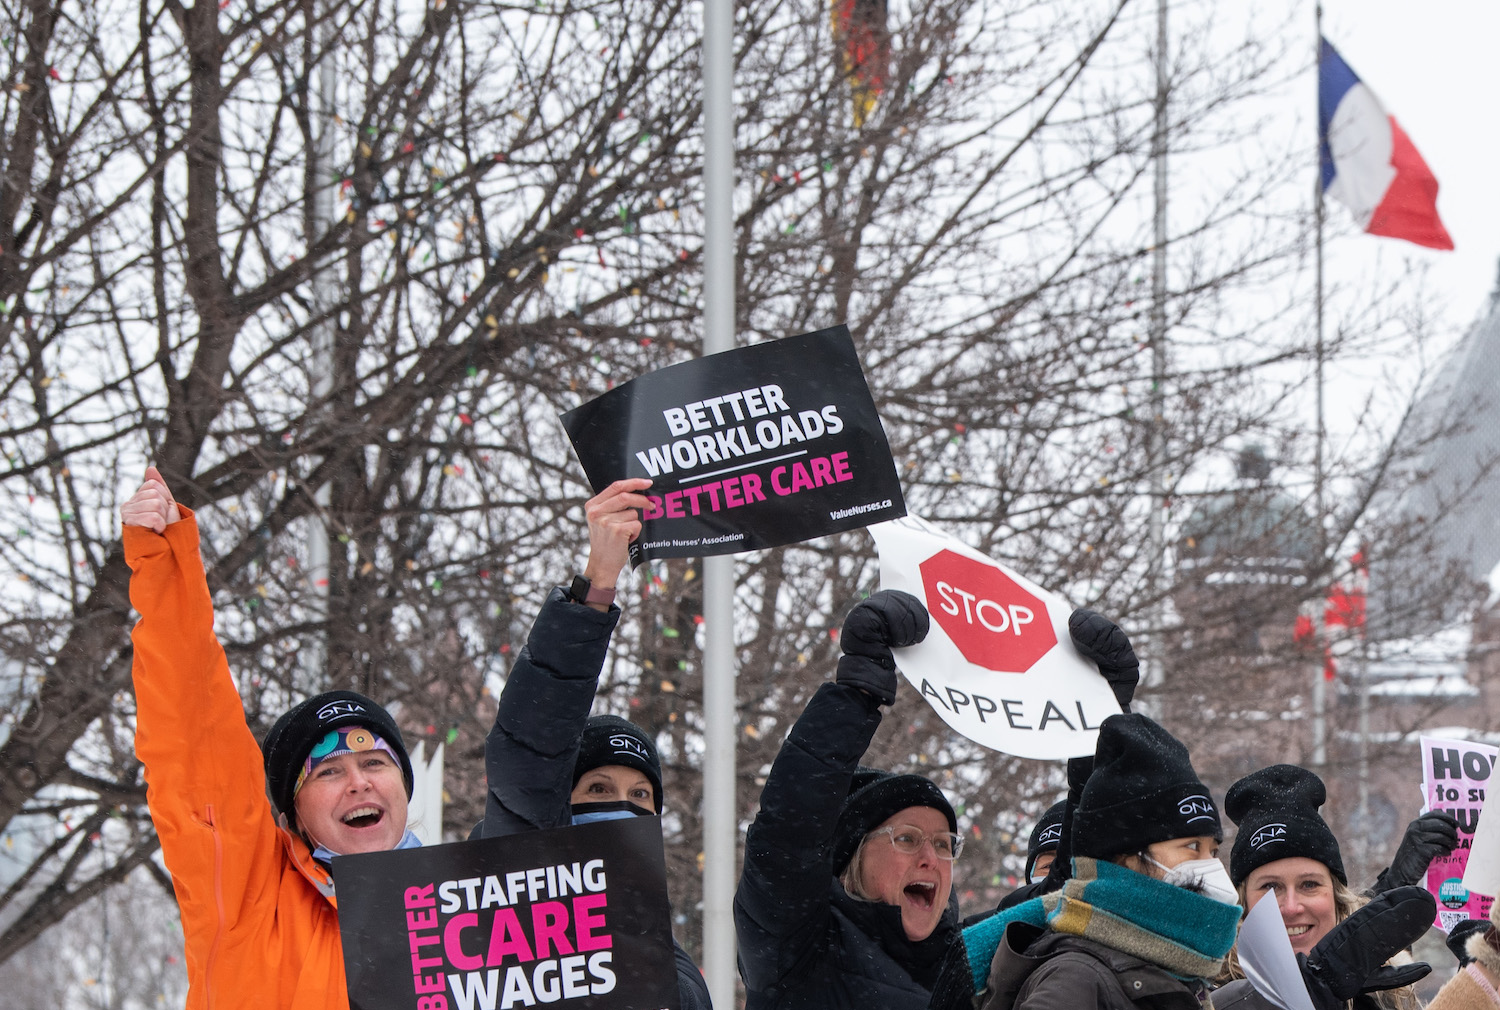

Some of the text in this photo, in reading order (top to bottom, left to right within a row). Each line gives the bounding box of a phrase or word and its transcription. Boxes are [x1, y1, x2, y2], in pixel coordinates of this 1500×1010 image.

[663, 384, 790, 437] BETTER
[636, 405, 844, 477] WORKLOADS
[642, 451, 854, 520] BETTER CARE
[830, 499, 892, 521] ValueNurses.ca
[643, 540, 671, 550] Ontario
[701, 533, 745, 545] Association
[936, 581, 1034, 636] STOP
[318, 703, 367, 720] ONA
[921, 678, 1101, 732] APPEAL
[610, 738, 650, 758] ONA
[1436, 784, 1459, 801] to
[1179, 801, 1214, 815] ONA
[1038, 826, 1062, 843] ON
[1250, 827, 1286, 847] ONA
[438, 859, 607, 914] STAFFING
[443, 893, 612, 971] CARE
